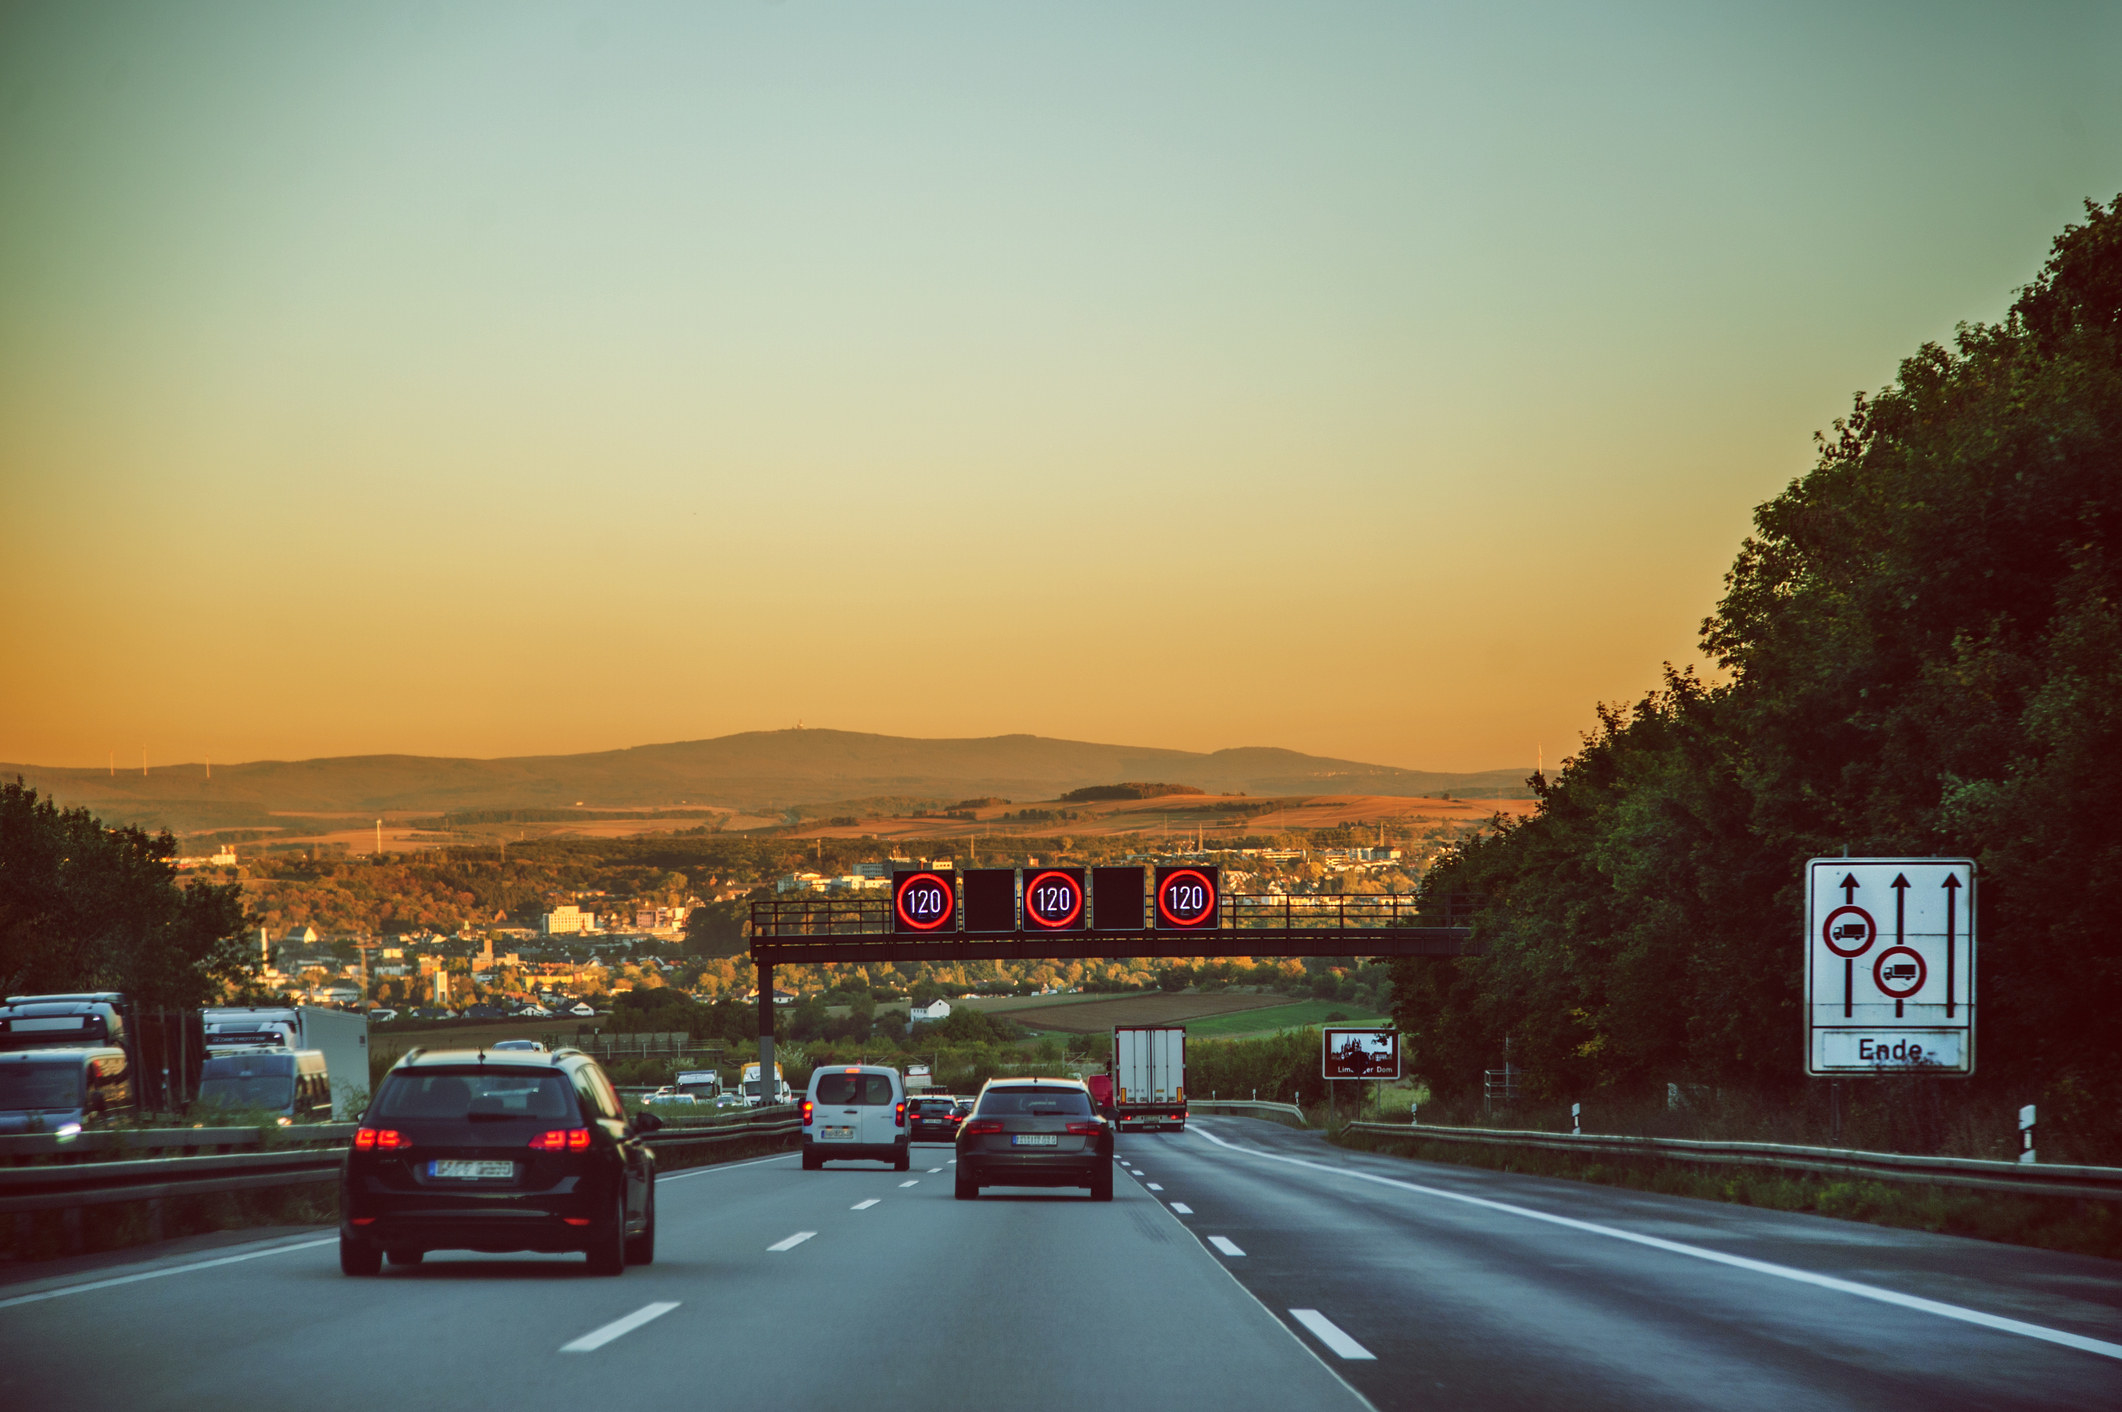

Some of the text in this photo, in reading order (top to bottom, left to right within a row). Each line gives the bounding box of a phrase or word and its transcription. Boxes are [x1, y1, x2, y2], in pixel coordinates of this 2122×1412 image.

[908, 889, 941, 914] 120
[1037, 887, 1070, 911] 120
[1169, 886, 1203, 910] 120
[1859, 1038, 1923, 1062] Ende
[1337, 1066, 1393, 1075] Limer Dom
